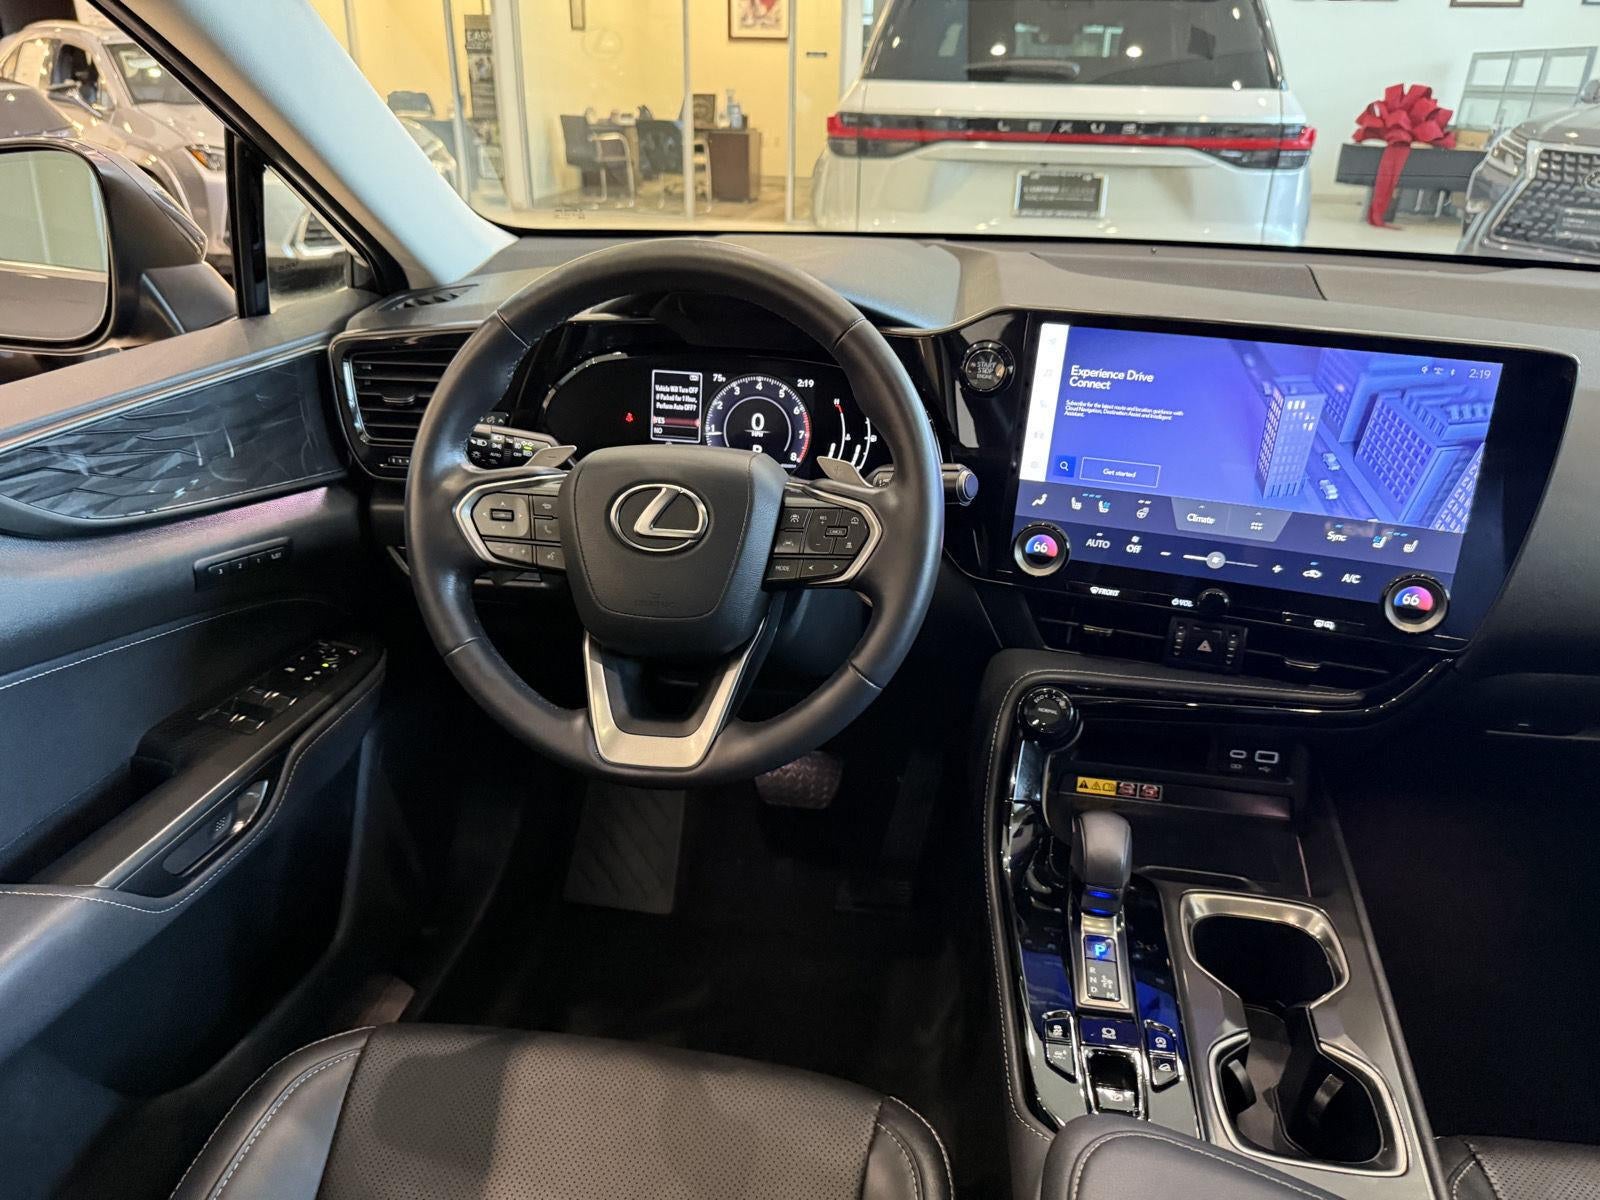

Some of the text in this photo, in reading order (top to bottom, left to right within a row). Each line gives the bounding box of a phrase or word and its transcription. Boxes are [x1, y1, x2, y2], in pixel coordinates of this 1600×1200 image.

[997, 120, 1137, 135] LEXUS
[1070, 364, 1154, 382] Experience Drive
[1468, 368, 1491, 379] 2:19
[756, 381, 762, 390] 4
[797, 379, 814, 388] 2:19
[1069, 376, 1111, 390] Connect
[734, 387, 740, 396] 3
[778, 390, 785, 398] 5
[716, 402, 723, 410] 2
[794, 406, 800, 414] 6
[751, 412, 765, 430] 0
[710, 424, 716, 432] 1
[798, 430, 804, 439] 7
[790, 452, 797, 461] 8
[1102, 468, 1136, 478] Get started
[1186, 513, 1216, 525] Climate
[1326, 531, 1348, 542] Sync
[1033, 541, 1048, 553] 66
[1086, 538, 1110, 549] AUTO
[1341, 573, 1362, 584] A/C
[1402, 593, 1420, 606] 66
[1095, 944, 1106, 956] P
